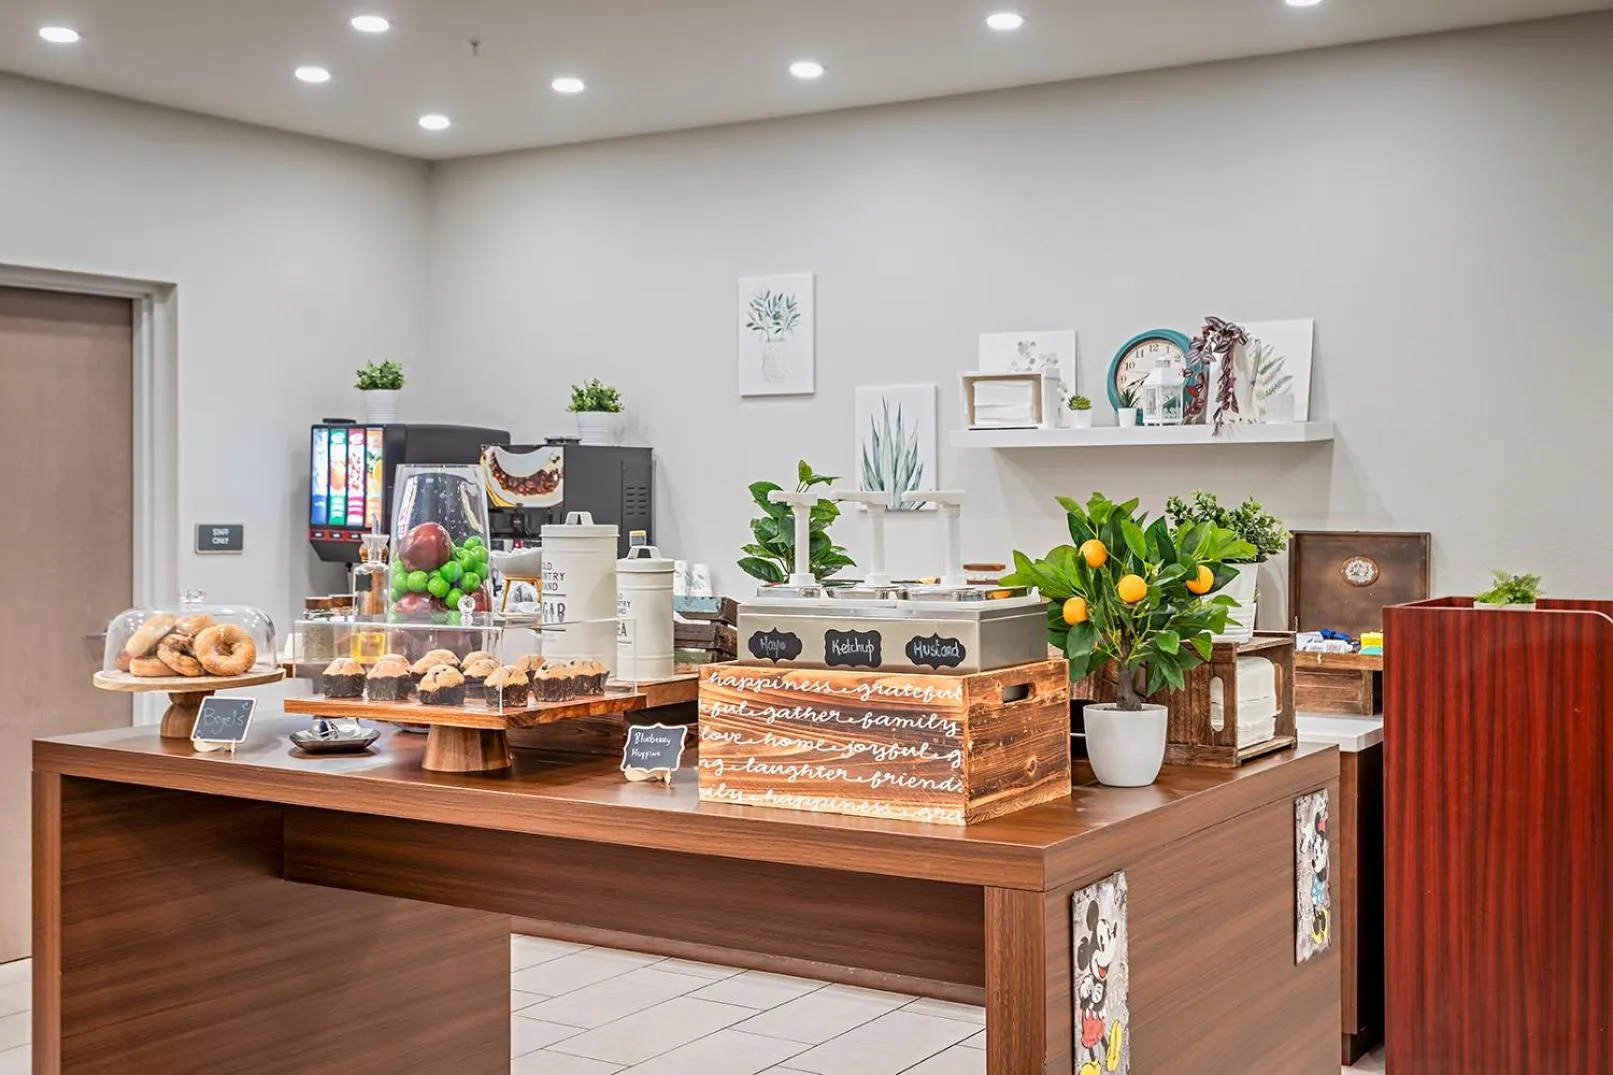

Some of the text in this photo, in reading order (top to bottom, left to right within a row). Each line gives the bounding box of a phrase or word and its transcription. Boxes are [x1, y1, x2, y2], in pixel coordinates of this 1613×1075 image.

[1135, 349, 1145, 359] 11
[1149, 344, 1160, 353] 12
[1166, 346, 1171, 354] 1
[1125, 361, 1136, 371] 10
[1174, 354, 1181, 362] 2
[831, 638, 875, 662] Ketchup
[913, 641, 960, 659] Mustard
[709, 672, 962, 702] happiness grateful
[760, 706, 840, 724] gather
[859, 712, 960, 737] family
[635, 732, 671, 746] Blueberry
[700, 725, 742, 744] love
[763, 732, 825, 751] home
[840, 740, 930, 761] joyful
[744, 757, 848, 783] laughter
